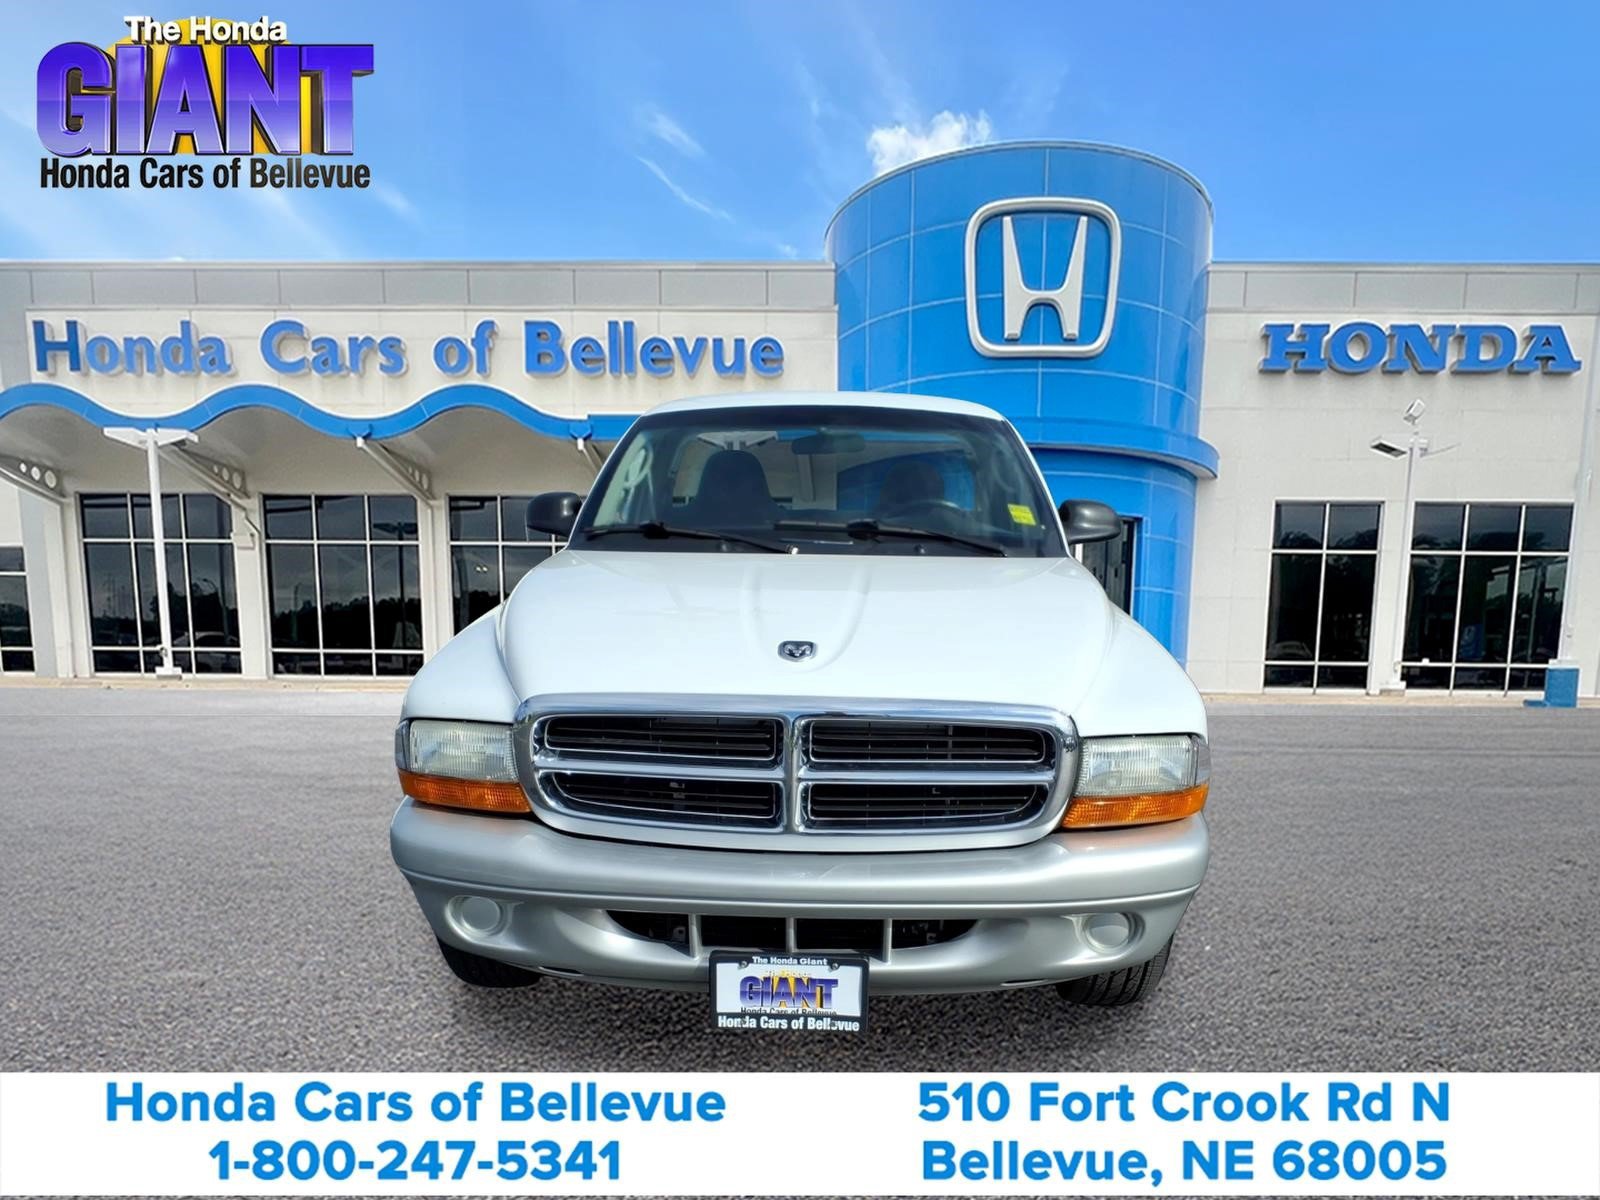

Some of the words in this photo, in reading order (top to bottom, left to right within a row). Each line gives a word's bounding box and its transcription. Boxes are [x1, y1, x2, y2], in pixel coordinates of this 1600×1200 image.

[33, 319, 233, 375] Honda
[260, 319, 406, 375] Cars
[433, 319, 498, 375] of
[524, 320, 785, 376] Bellevue
[1260, 322, 1582, 374] HONDA
[752, 956, 768, 964] The
[770, 956, 799, 965] Honda
[800, 957, 828, 966] Giant
[740, 976, 838, 1008] GIANT
[760, 1016, 788, 1029] Cars
[791, 1016, 805, 1030] of
